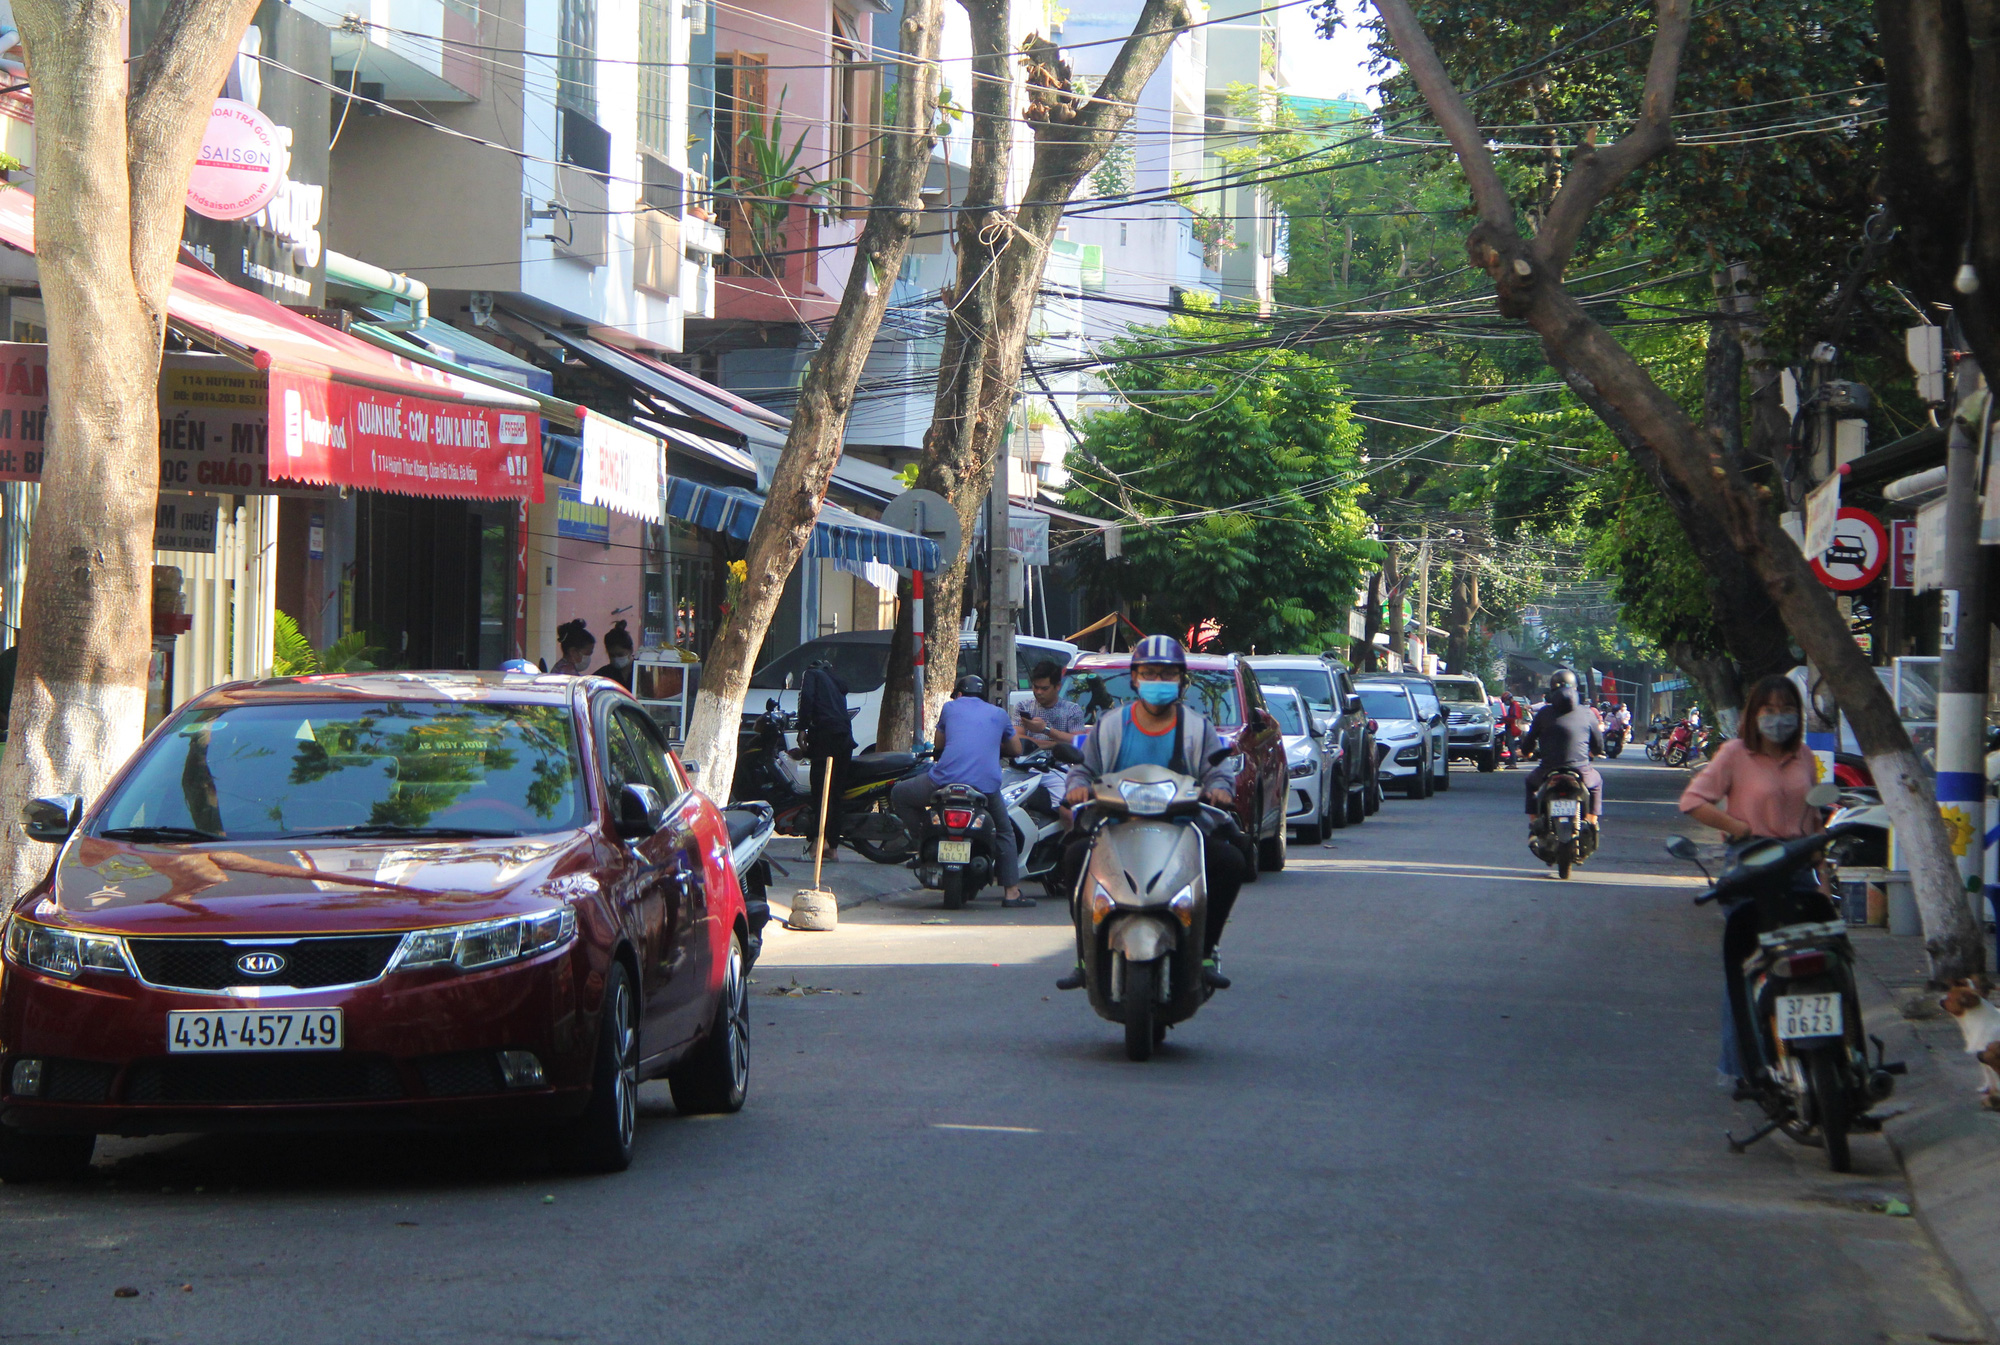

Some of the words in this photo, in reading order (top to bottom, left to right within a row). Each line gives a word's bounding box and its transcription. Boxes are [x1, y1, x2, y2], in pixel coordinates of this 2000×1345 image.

[201, 145, 271, 165] SAISON
[358, 395, 384, 436] QUÁN
[384, 398, 402, 439] HUẾ
[409, 410, 429, 443] CƠM
[435, 408, 453, 446] BÚN
[461, 411, 471, 447] MÌ
[472, 409, 491, 448] HẾN
[197, 457, 252, 487] CHÁO
[245, 956, 278, 970] KIA
[1787, 996, 1831, 1015] 37-Z7
[174, 1014, 337, 1048] 43A-457.49
[1788, 1014, 1833, 1034] 0623
